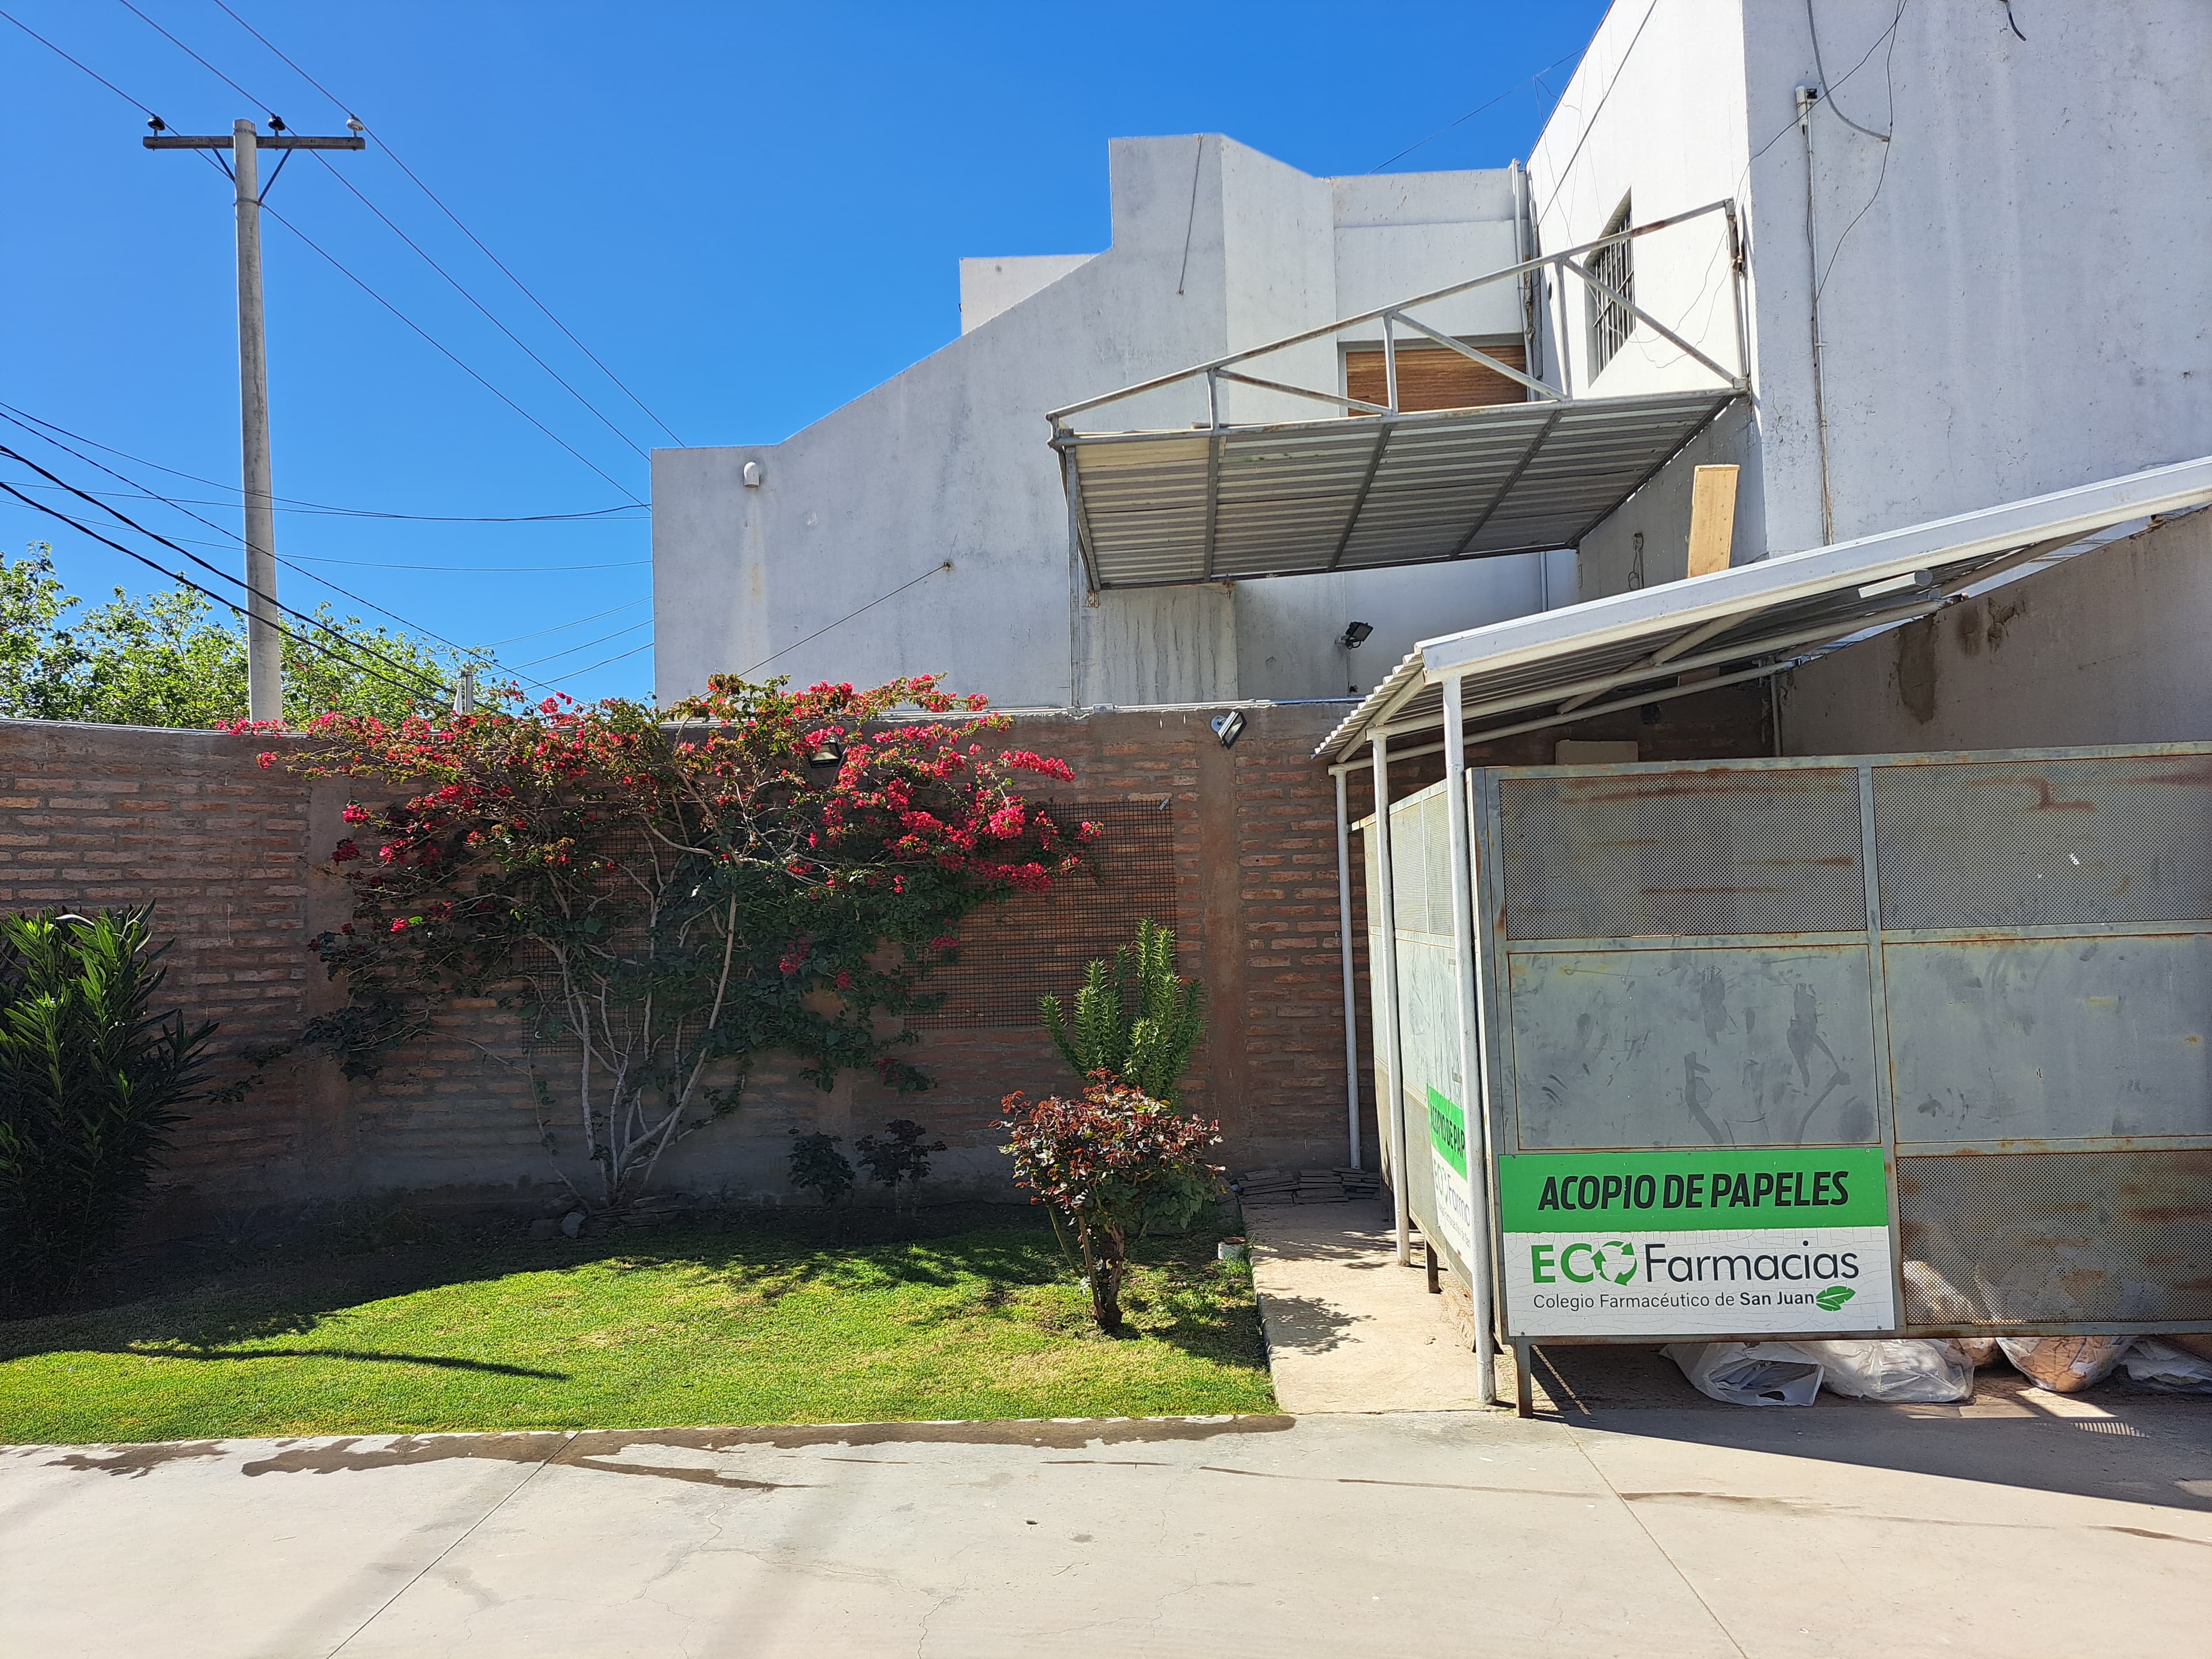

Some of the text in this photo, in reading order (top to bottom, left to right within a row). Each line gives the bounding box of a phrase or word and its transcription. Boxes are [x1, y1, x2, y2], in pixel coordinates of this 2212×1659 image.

[1446, 1118, 1453, 1150] DE
[1537, 1171, 1849, 1211] ACOPIO DE PAPELES
[1533, 1290, 1815, 1312] Colegio Farmacéutico de San Juan
